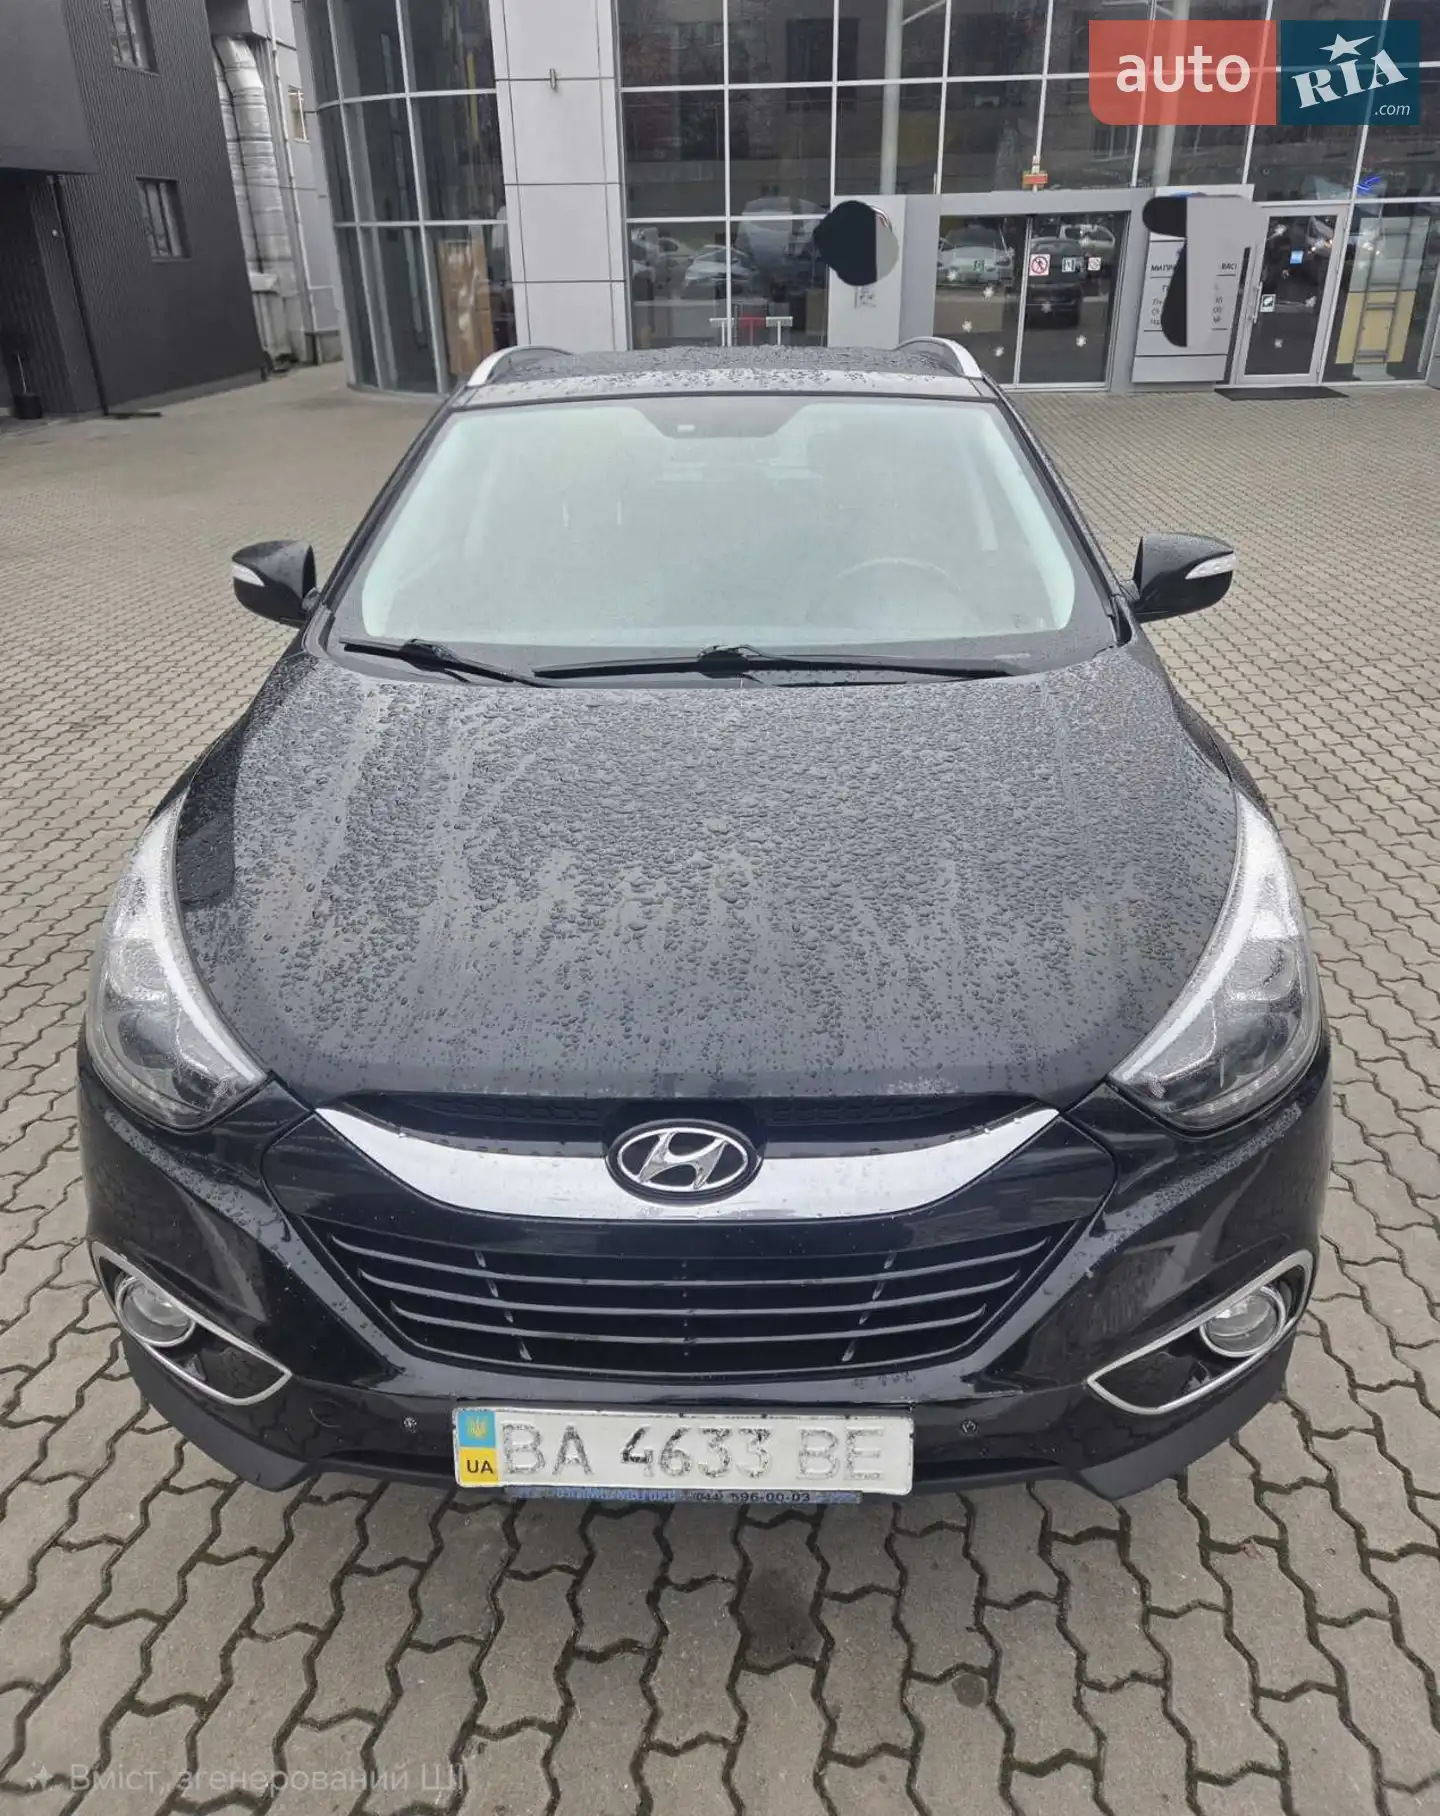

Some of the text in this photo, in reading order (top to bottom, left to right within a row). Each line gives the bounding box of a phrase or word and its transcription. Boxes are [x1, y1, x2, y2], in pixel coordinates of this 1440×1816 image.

[466, 1458, 494, 1475] UA
[503, 1422, 885, 1481] BA 4633 BE
